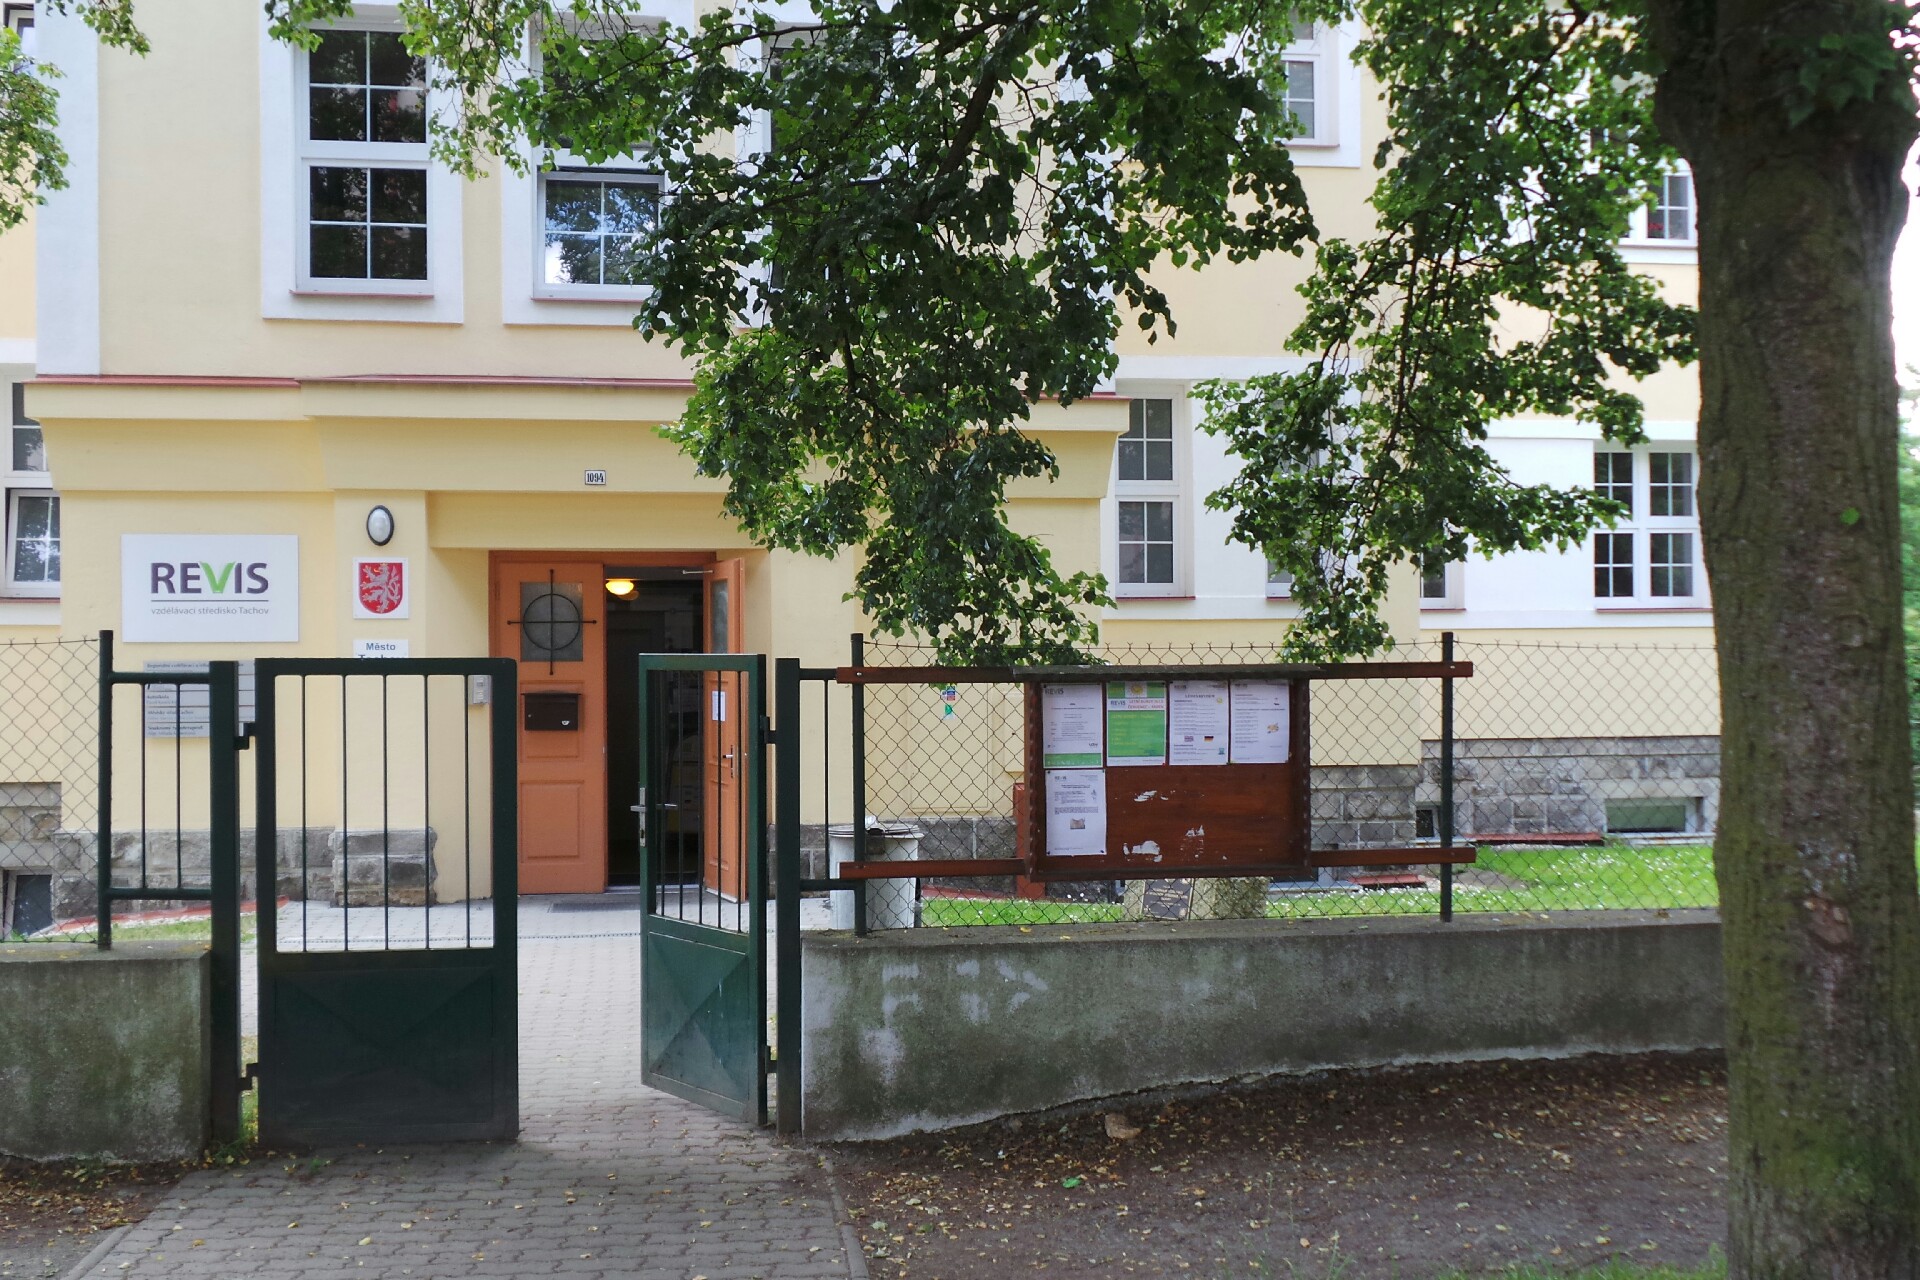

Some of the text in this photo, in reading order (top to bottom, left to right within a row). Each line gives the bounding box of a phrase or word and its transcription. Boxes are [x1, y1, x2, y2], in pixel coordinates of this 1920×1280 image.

[587, 472, 604, 483] 1094
[151, 561, 269, 594] REVIS
[151, 606, 269, 615] vzdělávací středisko Tachov
[366, 642, 396, 651] Město
